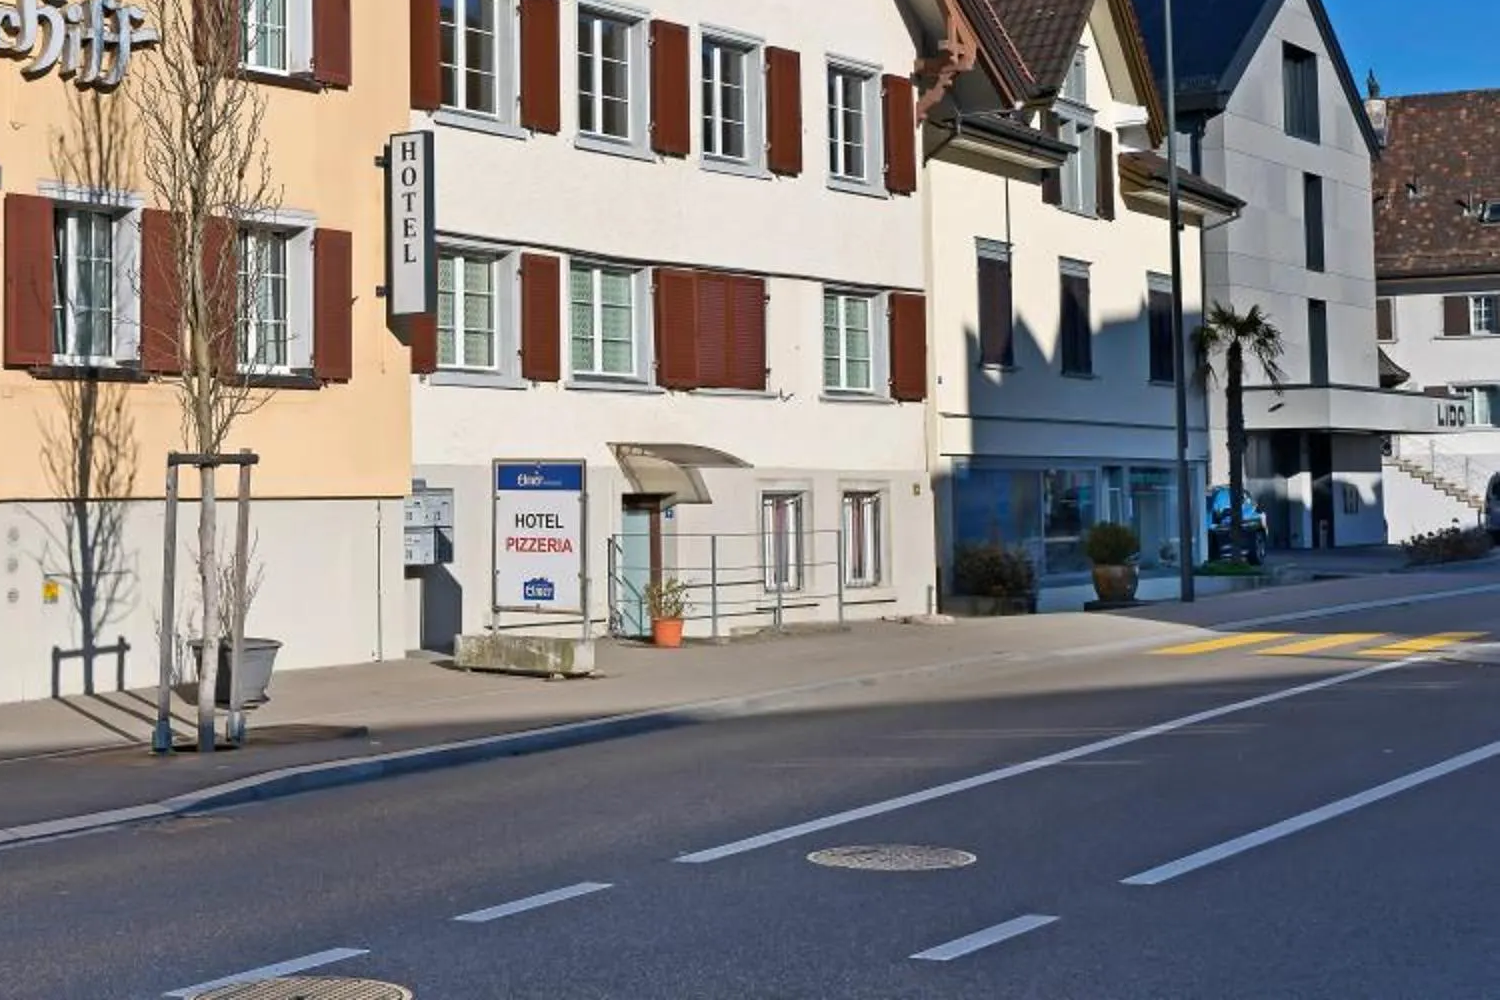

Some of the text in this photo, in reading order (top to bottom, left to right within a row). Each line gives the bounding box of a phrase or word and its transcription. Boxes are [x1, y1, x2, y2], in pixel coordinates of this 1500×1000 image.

[401, 141, 417, 264] HOTEL
[515, 513, 564, 529] HOTEL
[506, 537, 573, 553] PIZZERIA
